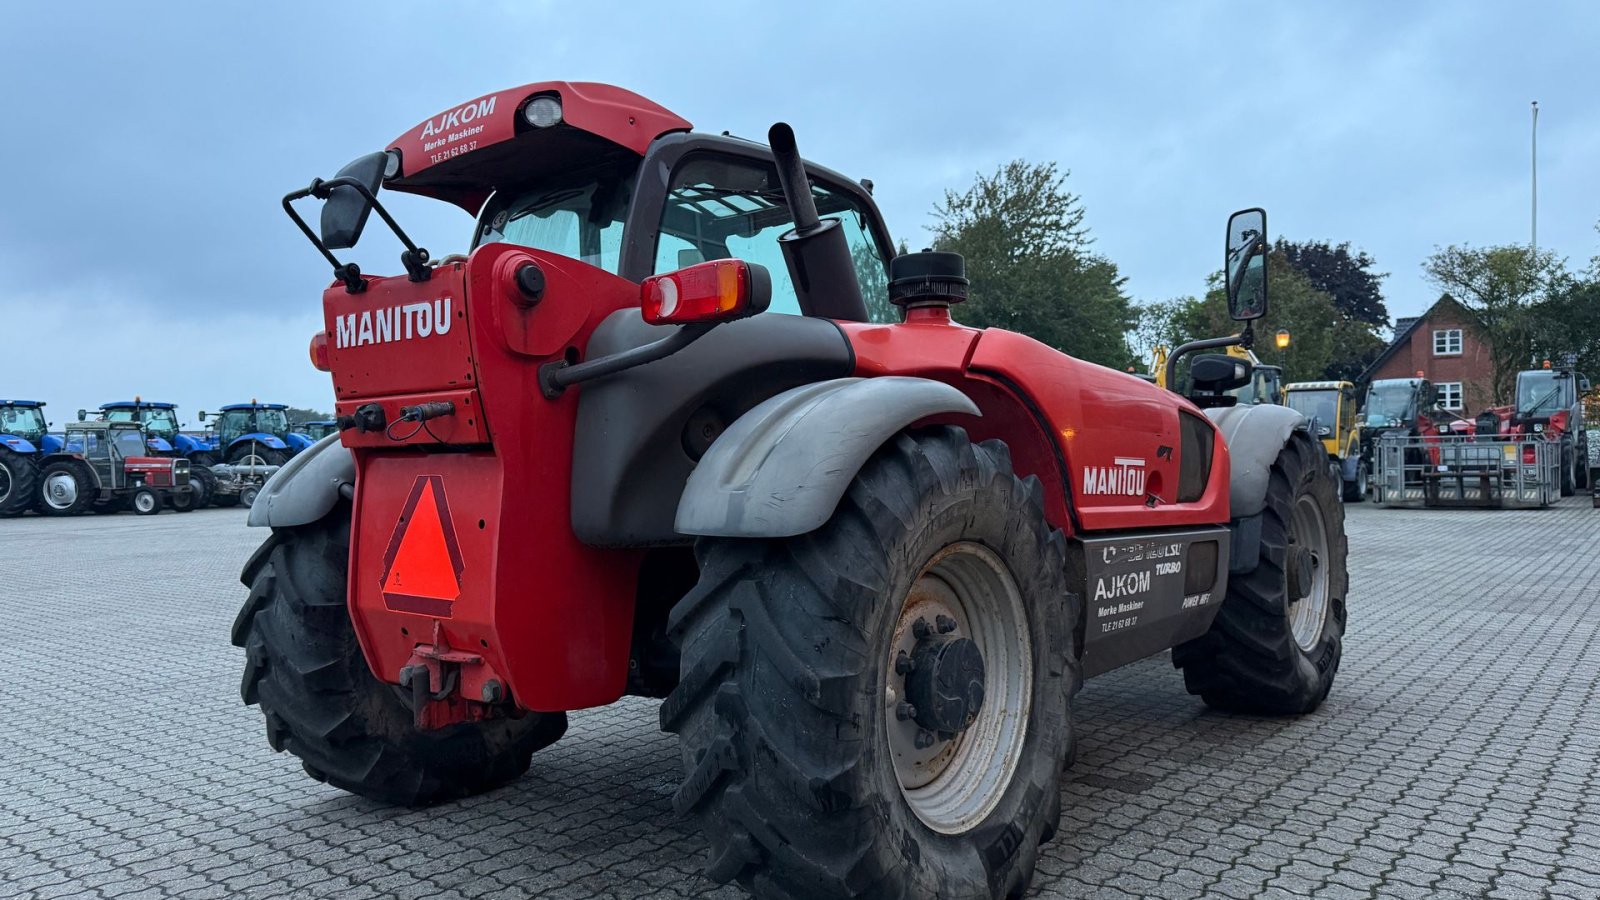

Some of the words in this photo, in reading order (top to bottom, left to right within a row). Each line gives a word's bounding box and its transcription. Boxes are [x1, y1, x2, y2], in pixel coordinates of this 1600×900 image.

[420, 96, 497, 140] AJKOM
[448, 124, 484, 143] Maskiner
[443, 150, 450, 160] 21
[451, 147, 459, 157] 62
[460, 143, 467, 153] 68
[470, 140, 477, 151] 37
[336, 298, 451, 349] MANITOU
[1083, 457, 1145, 496] MANITOU
[1155, 561, 1181, 576] TURBO
[1094, 571, 1150, 600] AJKOM
[1118, 600, 1144, 613] Maskiner
[1112, 620, 1118, 630] 21
[1118, 619, 1124, 629] 62
